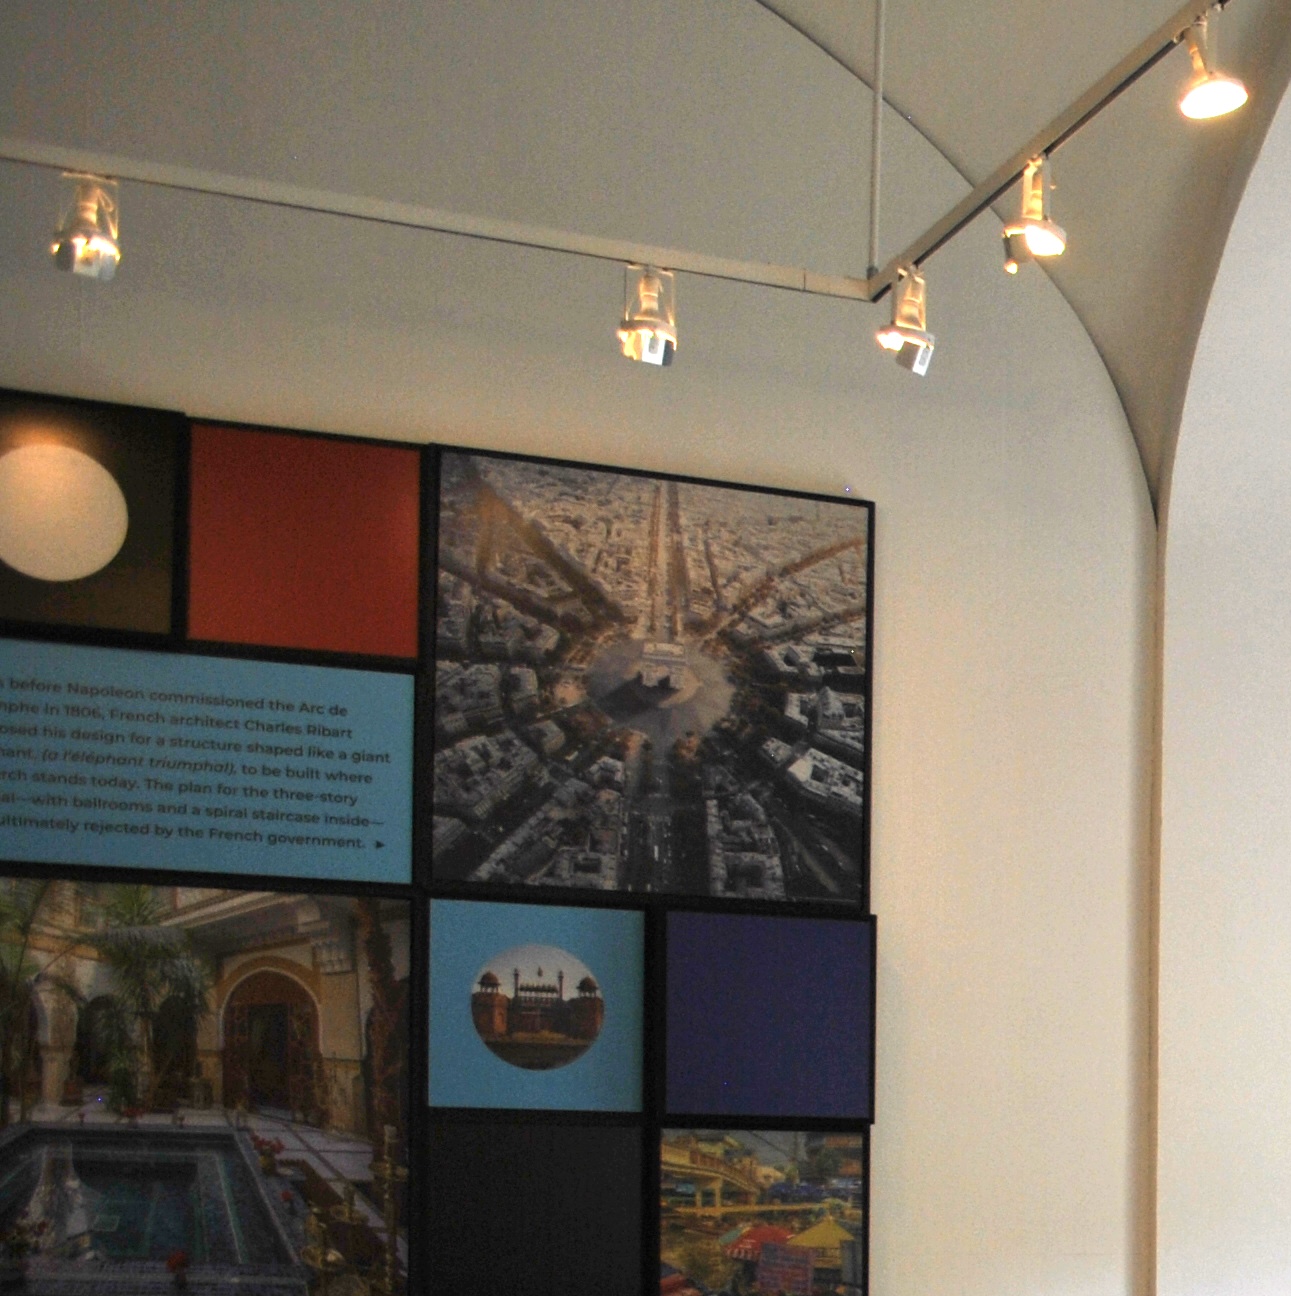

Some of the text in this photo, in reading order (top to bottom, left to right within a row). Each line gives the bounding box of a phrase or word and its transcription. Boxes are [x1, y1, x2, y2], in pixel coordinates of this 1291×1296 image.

[10, 678, 62, 693] before
[67, 683, 144, 700] Napoleon
[149, 692, 265, 709] commissioned
[269, 699, 294, 712] the
[299, 701, 324, 714] Arc
[329, 704, 348, 716] de
[45, 704, 60, 716] in
[64, 705, 105, 721] 1806,
[110, 709, 166, 724] French
[170, 715, 240, 730] architect
[244, 719, 302, 735] Charles
[306, 724, 353, 739] Ribart
[42, 726, 66, 739] his
[71, 728, 125, 746] design
[130, 733, 151, 745] for
[170, 736, 243, 752] structure
[247, 742, 303, 759] shaped
[308, 746, 334, 759] like
[351, 750, 391, 764] giant
[0, 770, 27, 781] rch
[32, 771, 86, 785] stands
[92, 775, 140, 792] today.
[144, 778, 173, 791] The
[178, 781, 212, 796] plan
[217, 783, 238, 796] for
[243, 785, 269, 798] the
[242, 764, 258, 776] to
[263, 765, 281, 777] be
[286, 767, 321, 780] built
[325, 770, 373, 784] where
[73, 795, 153, 812] ballrooms
[157, 802, 187, 814] and
[205, 805, 248, 820] spiral
[252, 808, 320, 823] staircase
[84, 820, 149, 835] rejected
[154, 824, 173, 840] by
[178, 826, 204, 838] the
[209, 828, 263, 842] French
[268, 834, 366, 849] government.
